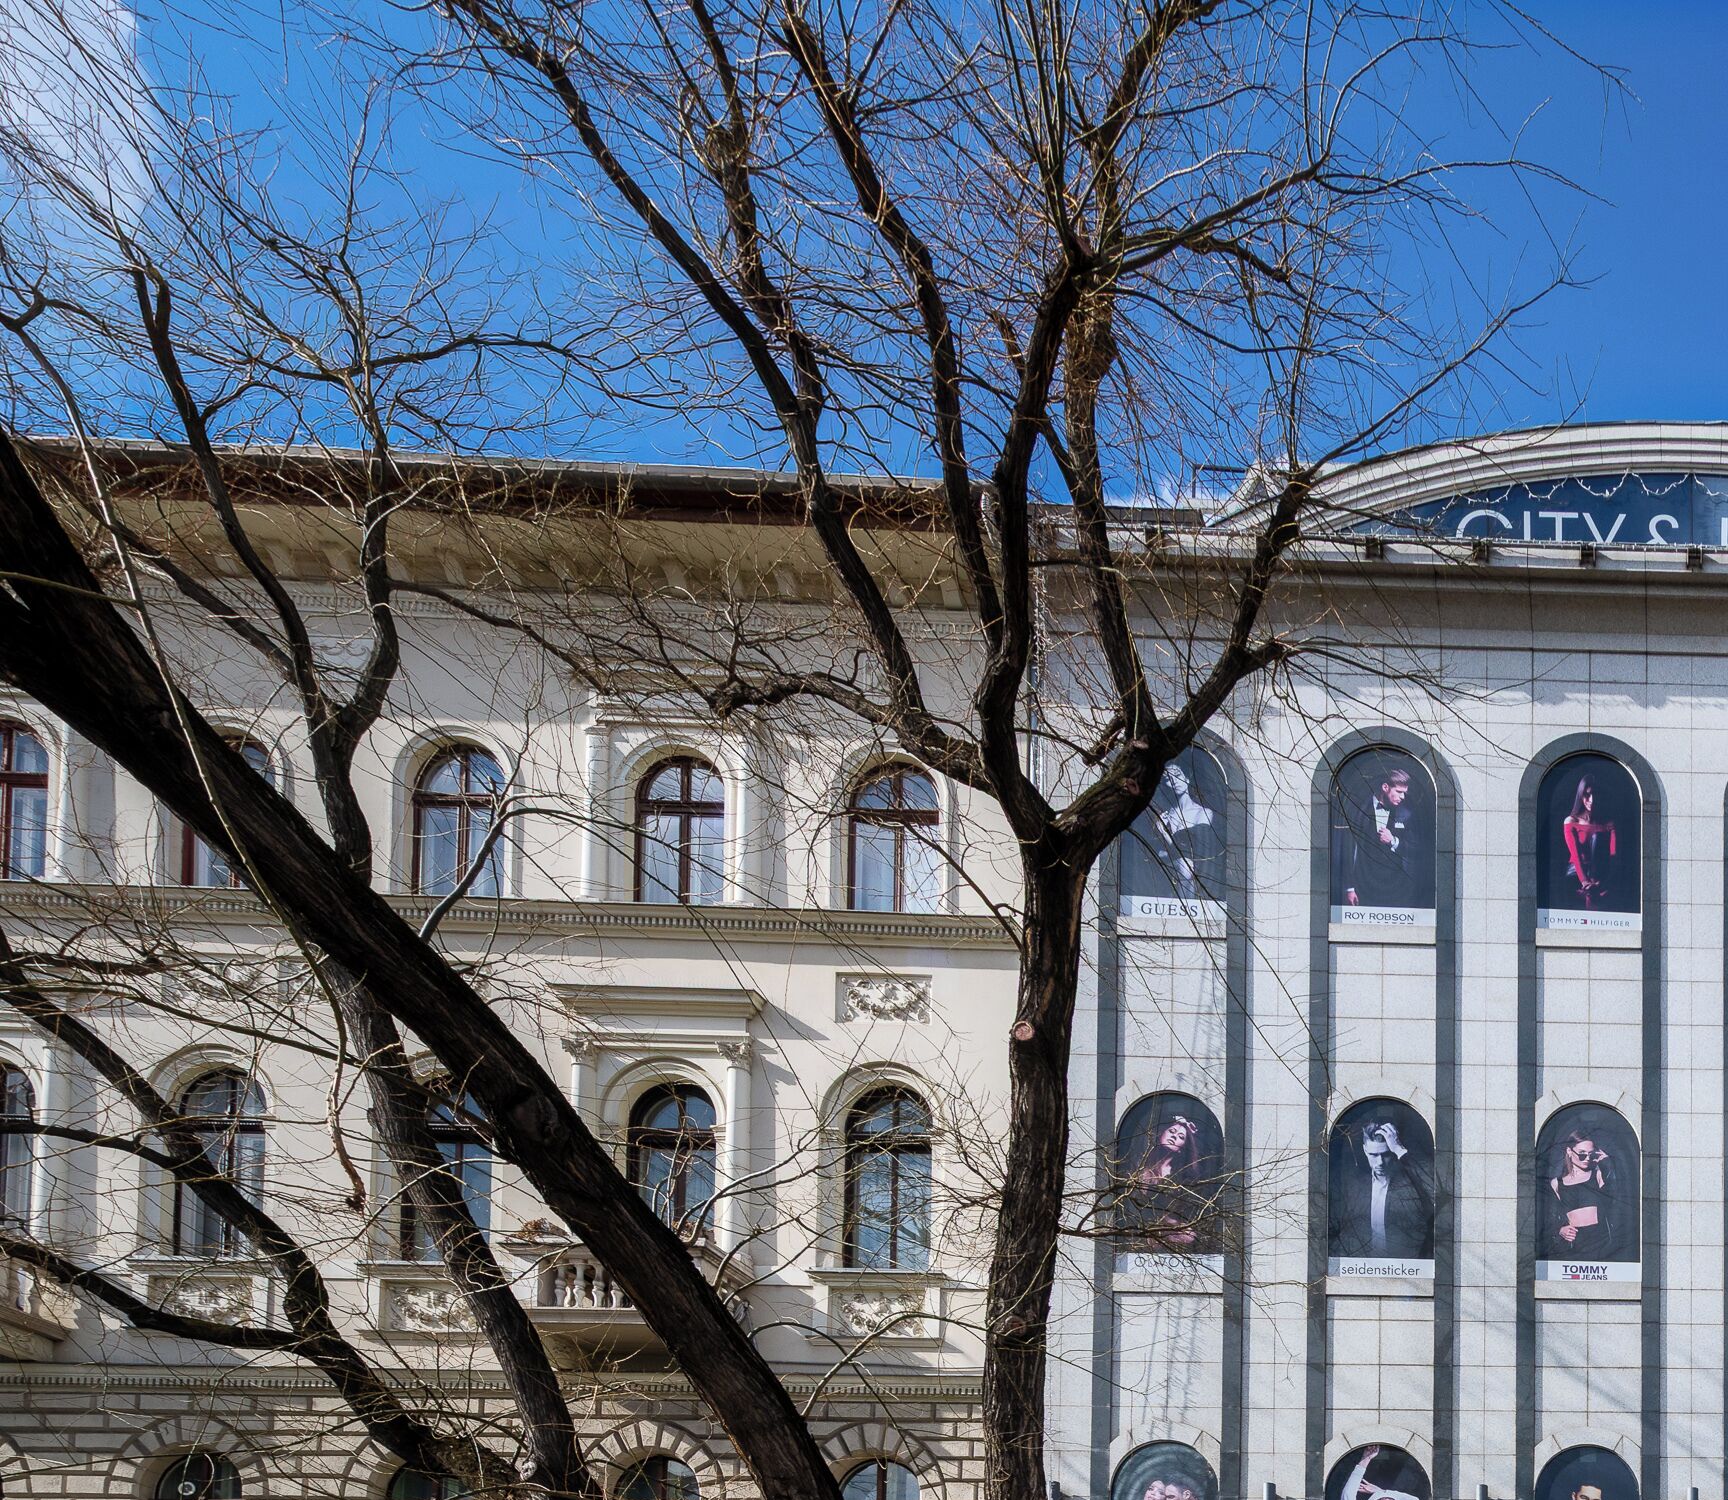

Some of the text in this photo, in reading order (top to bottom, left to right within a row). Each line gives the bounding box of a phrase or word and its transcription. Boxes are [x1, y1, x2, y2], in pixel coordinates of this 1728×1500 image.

[1140, 902, 1199, 918] GUESS
[1344, 910, 1415, 922] ROY ROBSON
[1590, 920, 1631, 928] HILFIGER
[1341, 1262, 1420, 1277] seidensticker
[1562, 1265, 1608, 1276] TOMMY
